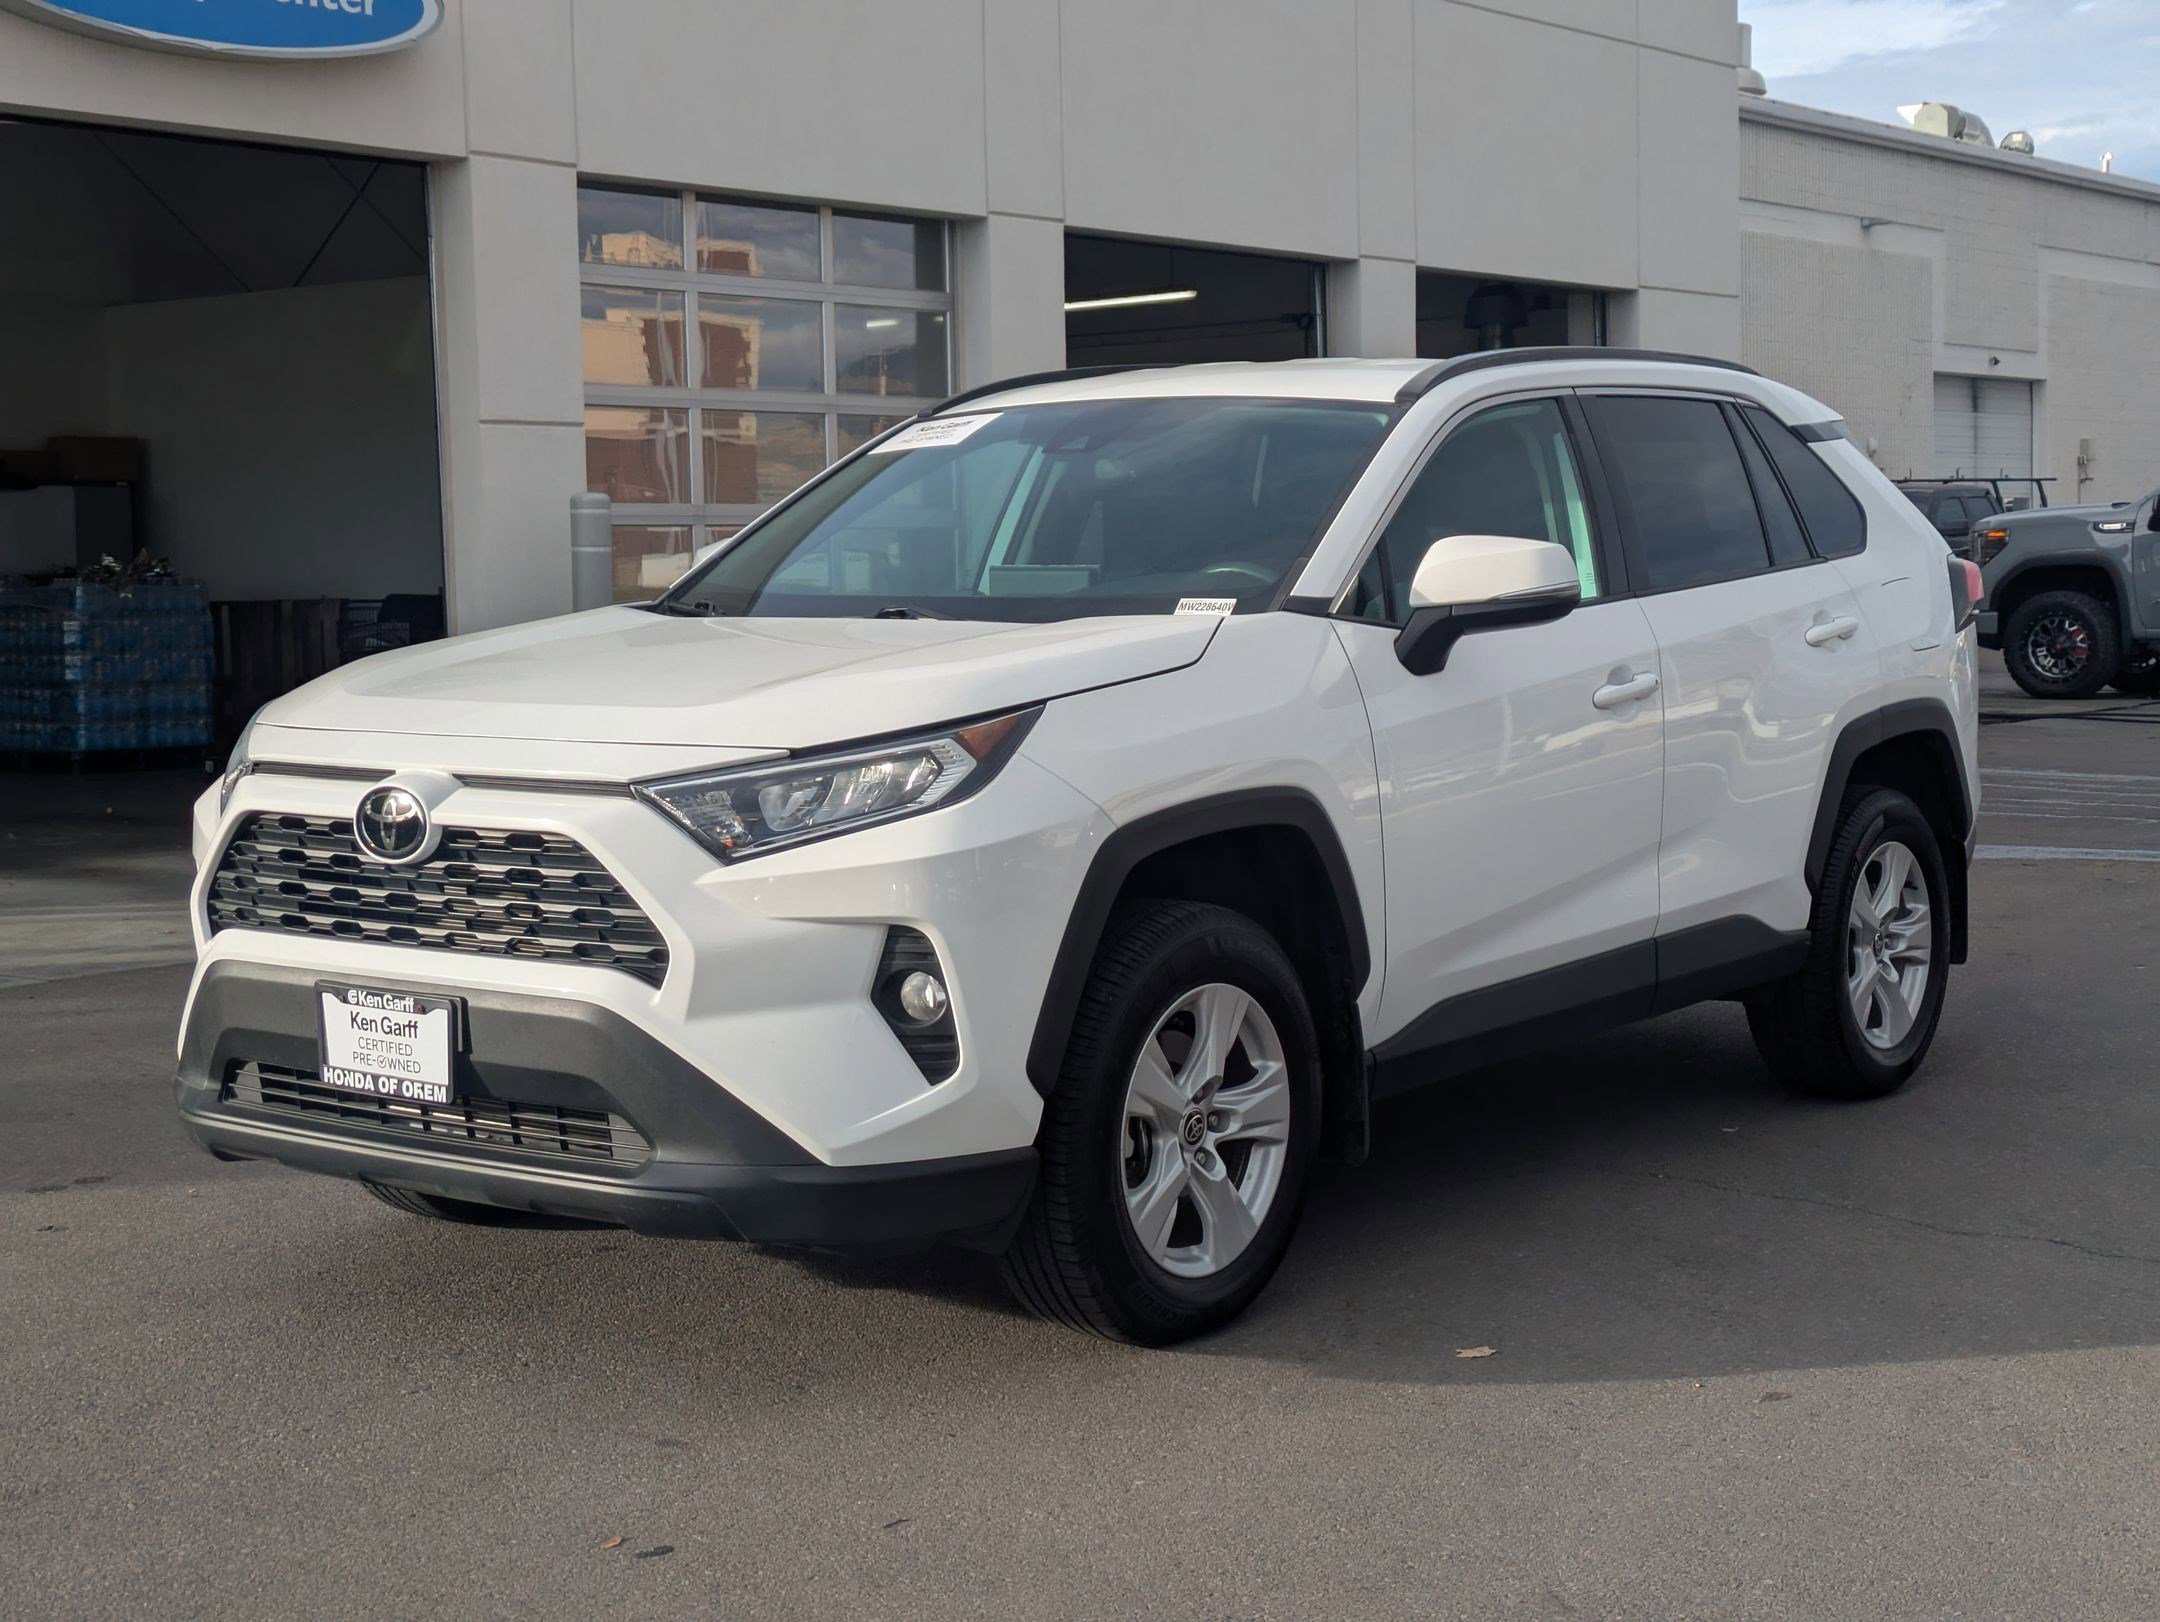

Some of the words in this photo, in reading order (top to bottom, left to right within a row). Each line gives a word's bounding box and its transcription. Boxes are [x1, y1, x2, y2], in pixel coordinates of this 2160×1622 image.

[350, 1010, 378, 1033] Ken
[381, 1016, 418, 1039] Garff
[358, 1036, 413, 1057] CERTIFIED
[323, 1066, 375, 1091] HONDA
[378, 1076, 398, 1095] OF
[402, 1080, 447, 1103] OREM
